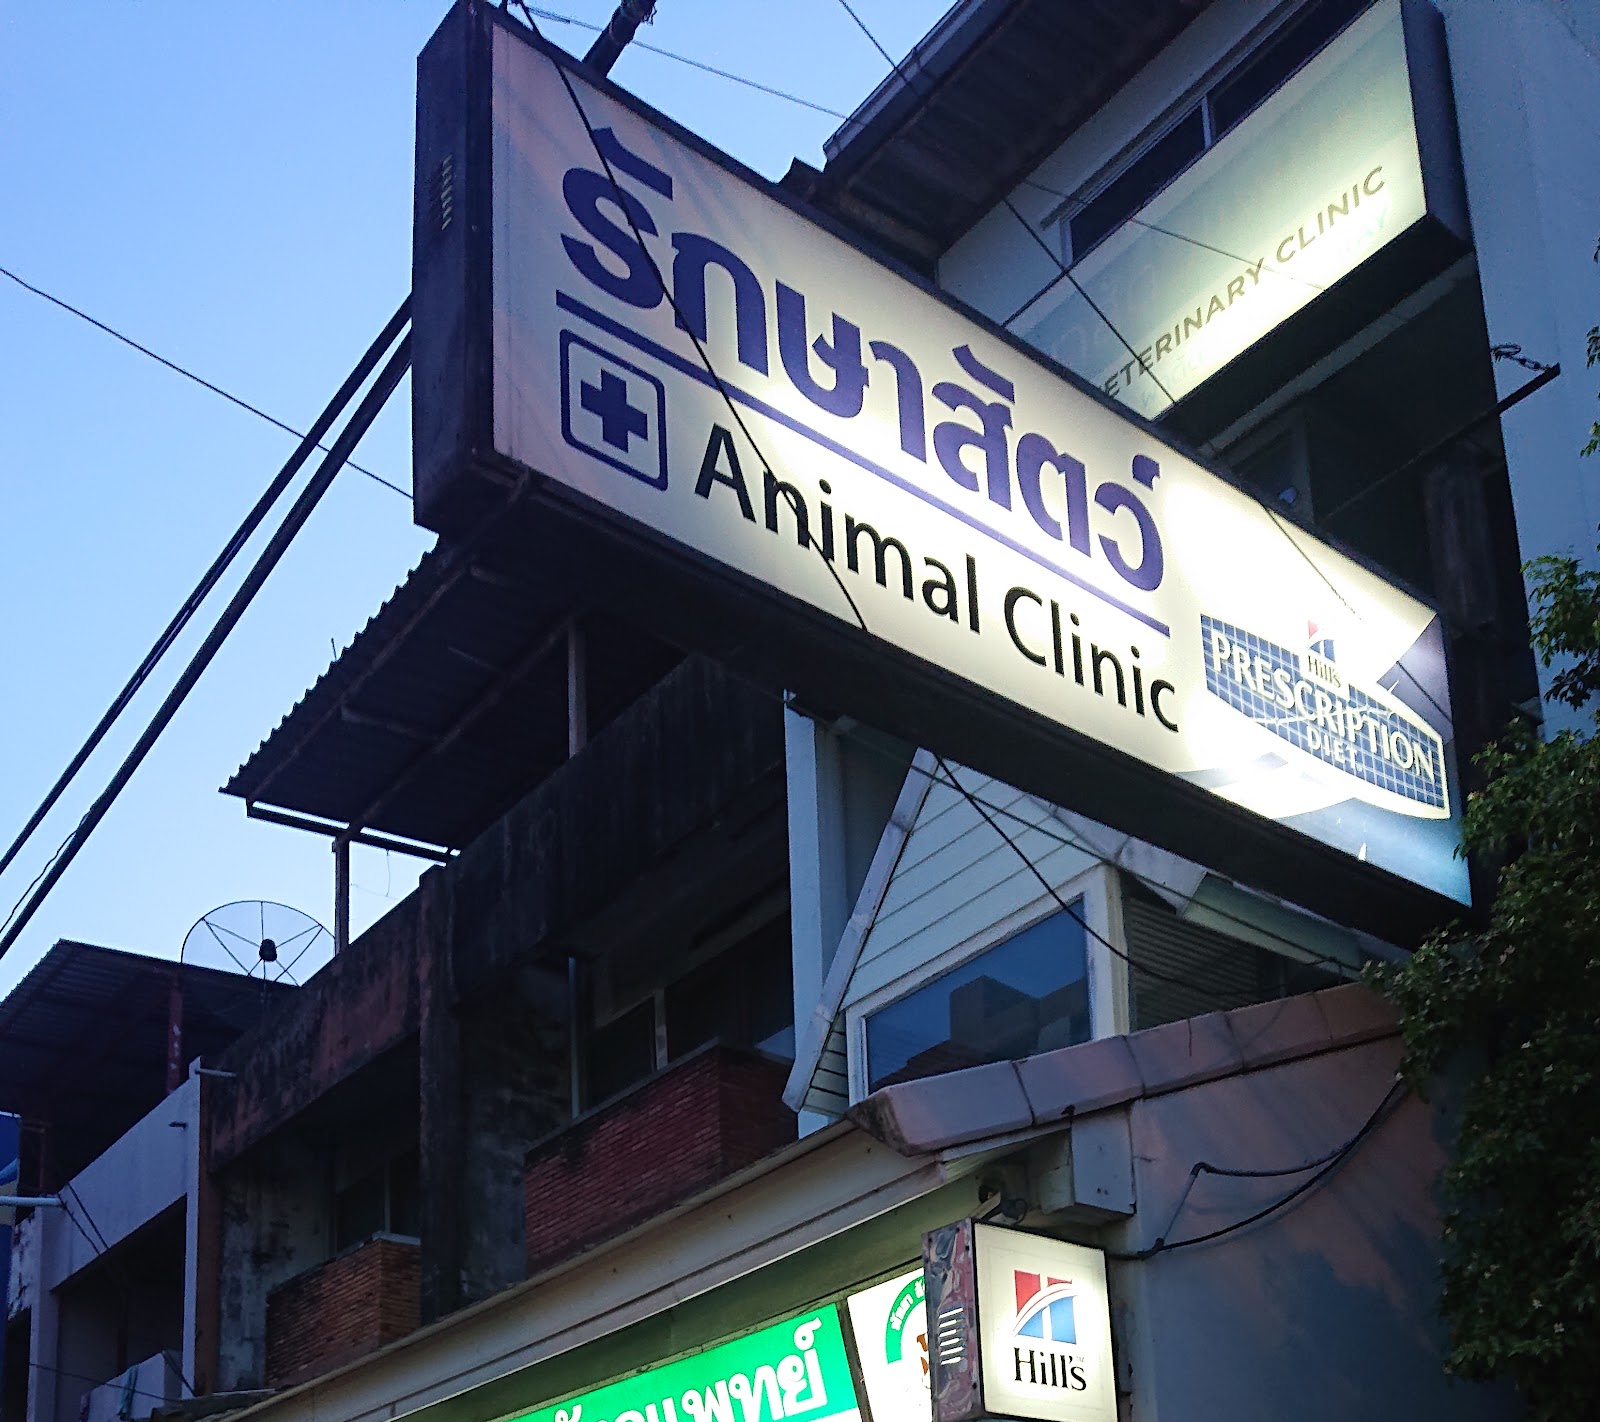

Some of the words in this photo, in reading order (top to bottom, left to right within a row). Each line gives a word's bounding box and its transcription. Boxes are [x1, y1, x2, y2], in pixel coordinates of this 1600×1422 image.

[560, 126, 1165, 593] รักษาสัตว์
[1101, 256, 1266, 400] ETERINARY
[1275, 164, 1386, 265] CLINIC
[693, 422, 981, 637] Animal
[1002, 585, 1180, 733] Clinic
[1210, 627, 1436, 783] PRESCRIPTION
[1305, 723, 1359, 770] DIET
[1307, 654, 1342, 689] Hill's
[1013, 1346, 1088, 1392] Hill's
